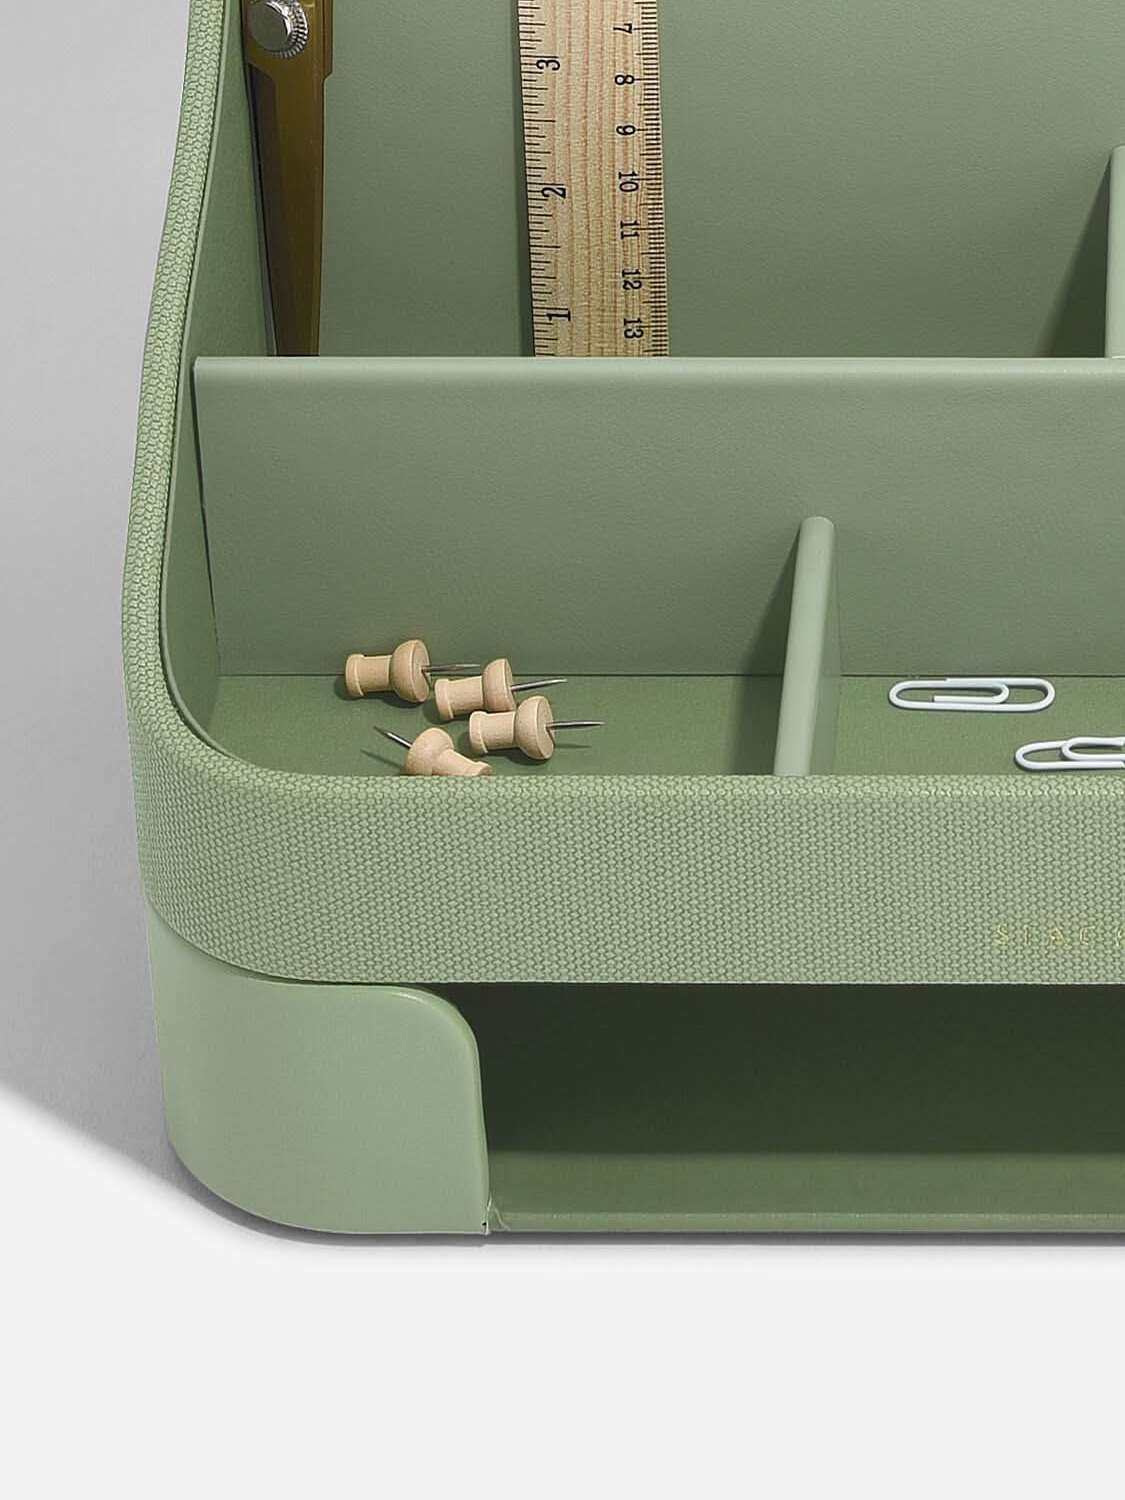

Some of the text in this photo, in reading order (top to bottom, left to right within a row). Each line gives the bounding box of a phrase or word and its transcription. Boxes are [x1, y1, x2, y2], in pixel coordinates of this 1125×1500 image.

[612, 23, 633, 34] 7
[536, 57, 560, 71] 3
[614, 73, 635, 86] 8
[616, 124, 636, 136] 9
[617, 171, 639, 193] 10
[541, 186, 566, 199] 2
[619, 220, 640, 240] 11
[621, 268, 642, 290] 12
[546, 310, 571, 322] 1
[623, 317, 644, 339] 13
